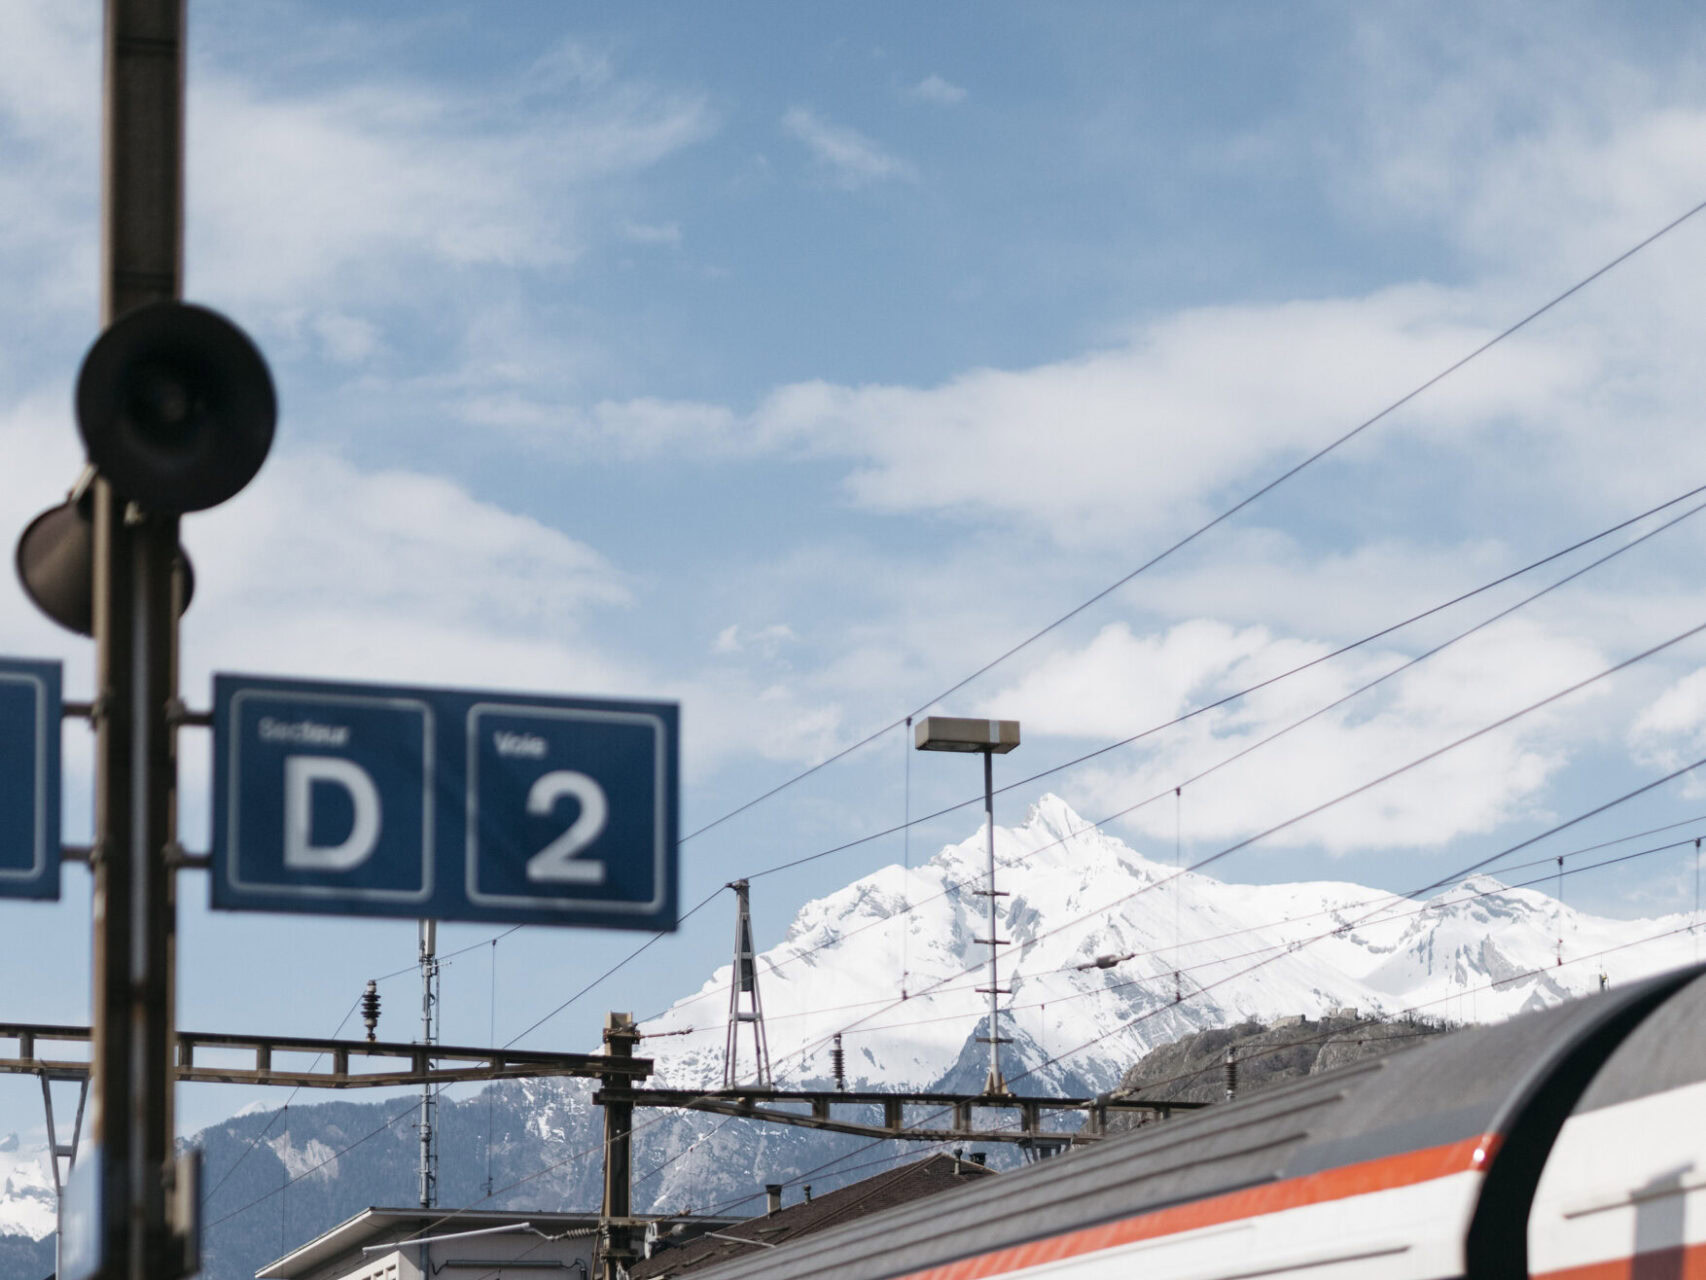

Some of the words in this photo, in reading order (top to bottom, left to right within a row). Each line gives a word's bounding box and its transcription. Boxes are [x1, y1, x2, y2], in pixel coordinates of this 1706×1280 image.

[258, 717, 349, 747] Secteur
[493, 730, 548, 758] Voie
[284, 756, 382, 871] D
[526, 770, 608, 884] 2
